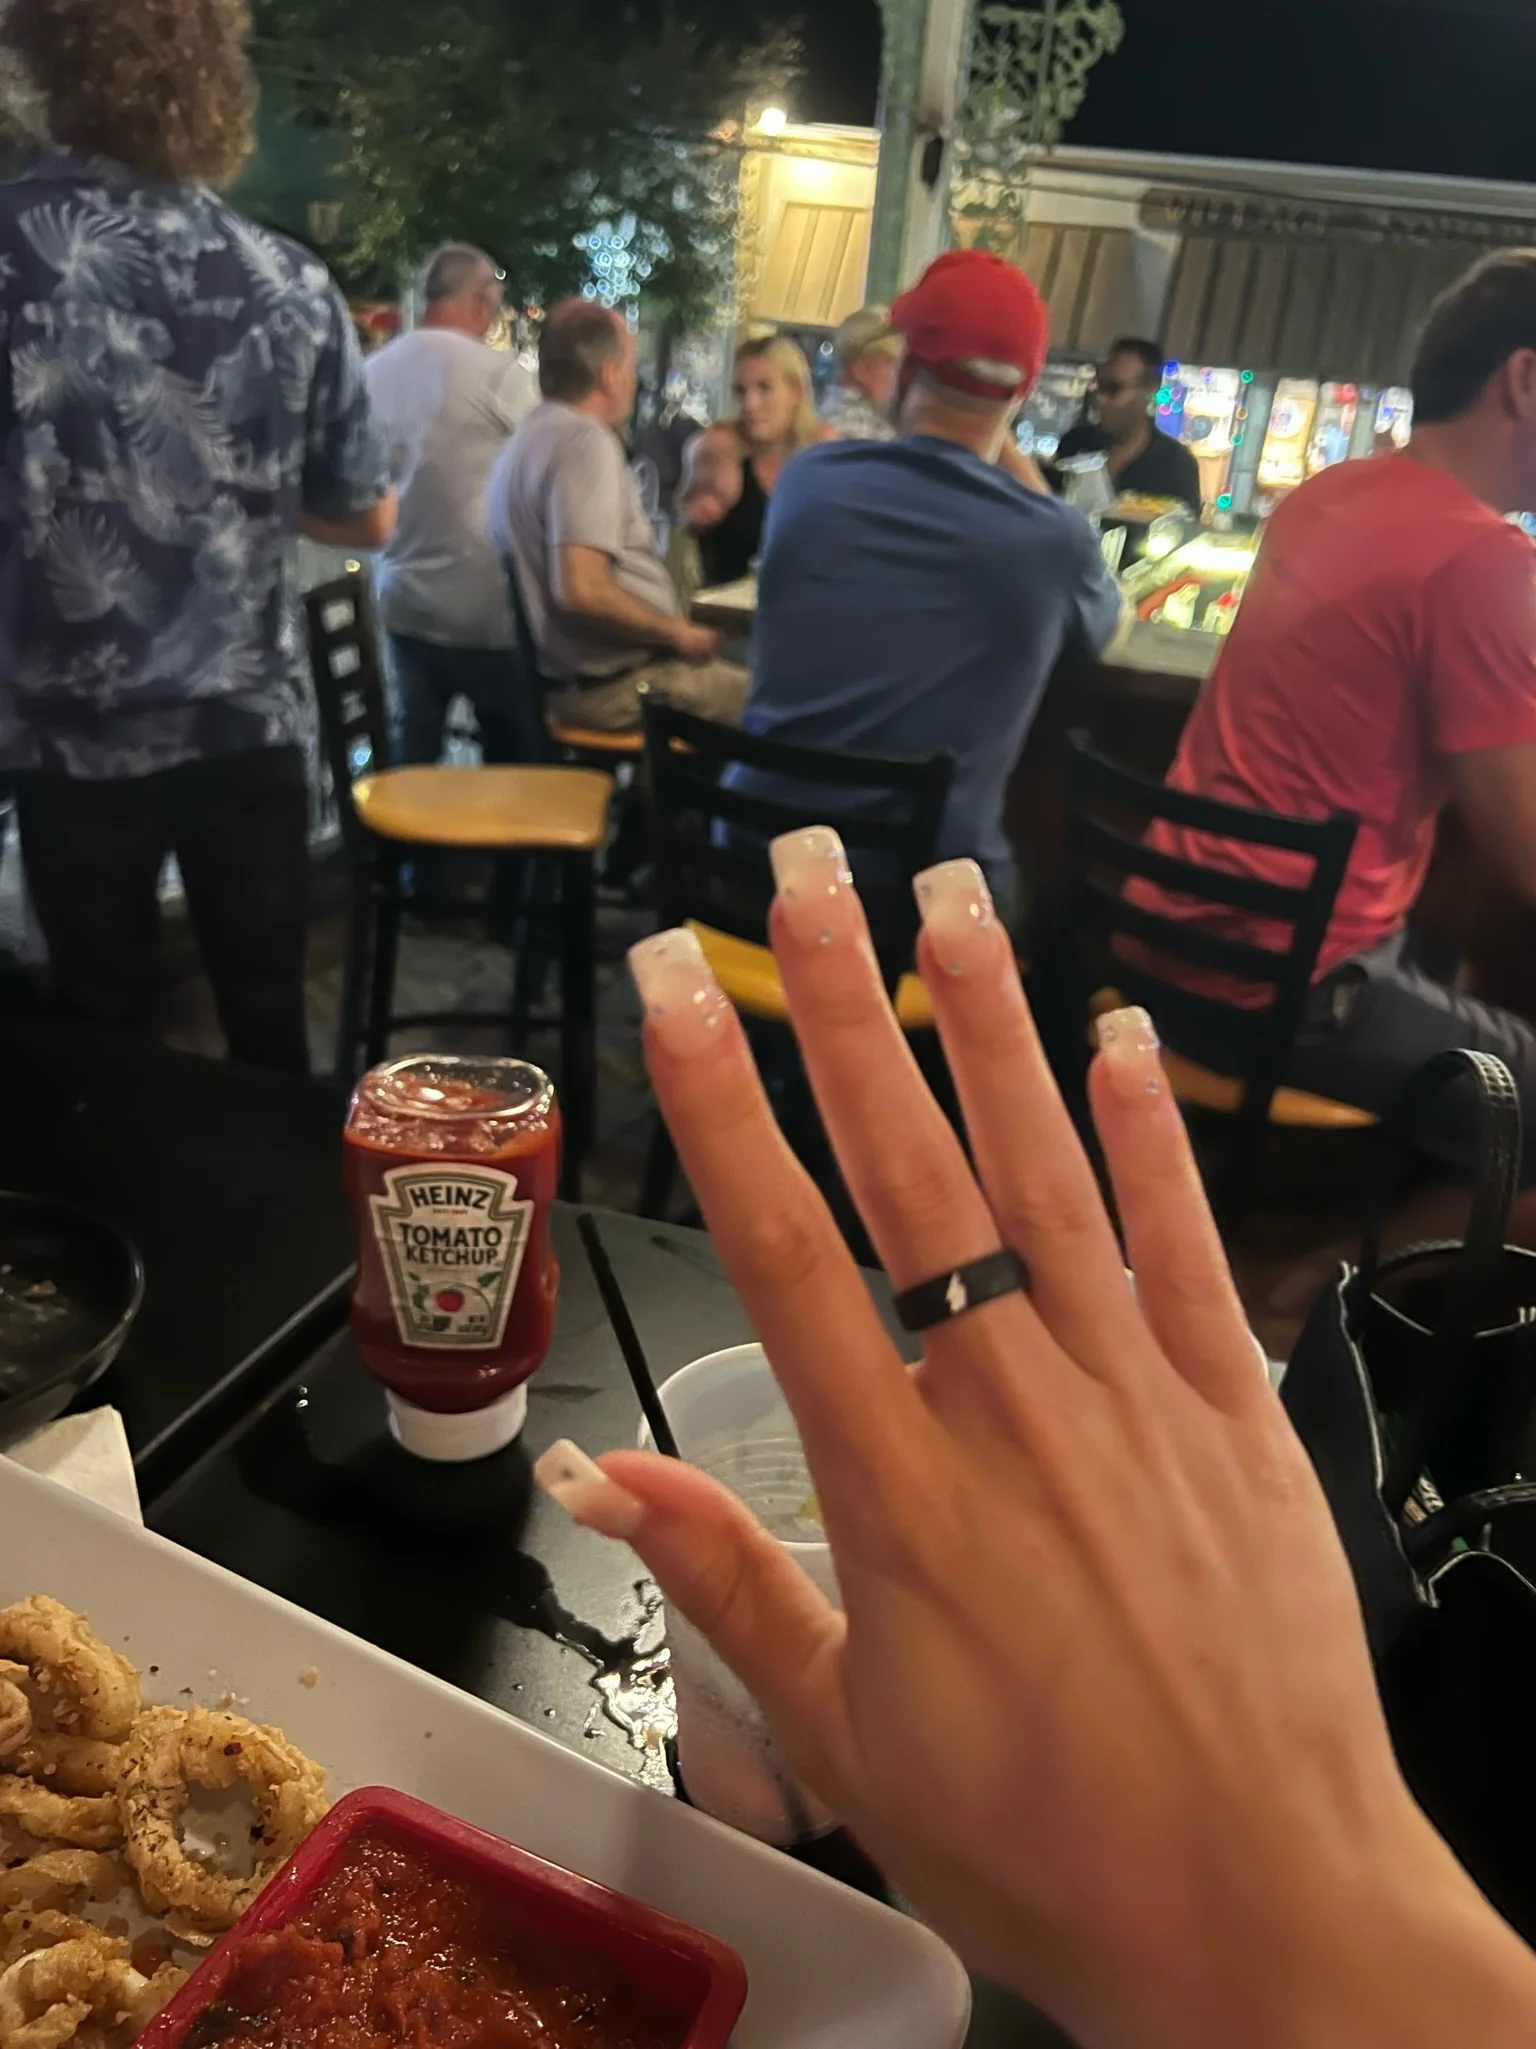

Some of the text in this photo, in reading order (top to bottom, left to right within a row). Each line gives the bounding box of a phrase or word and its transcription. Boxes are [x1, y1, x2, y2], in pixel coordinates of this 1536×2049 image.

[410, 1185, 491, 1209] HEINZ
[400, 1223, 502, 1247] TOMATO
[406, 1247, 498, 1265] KETCHUP
